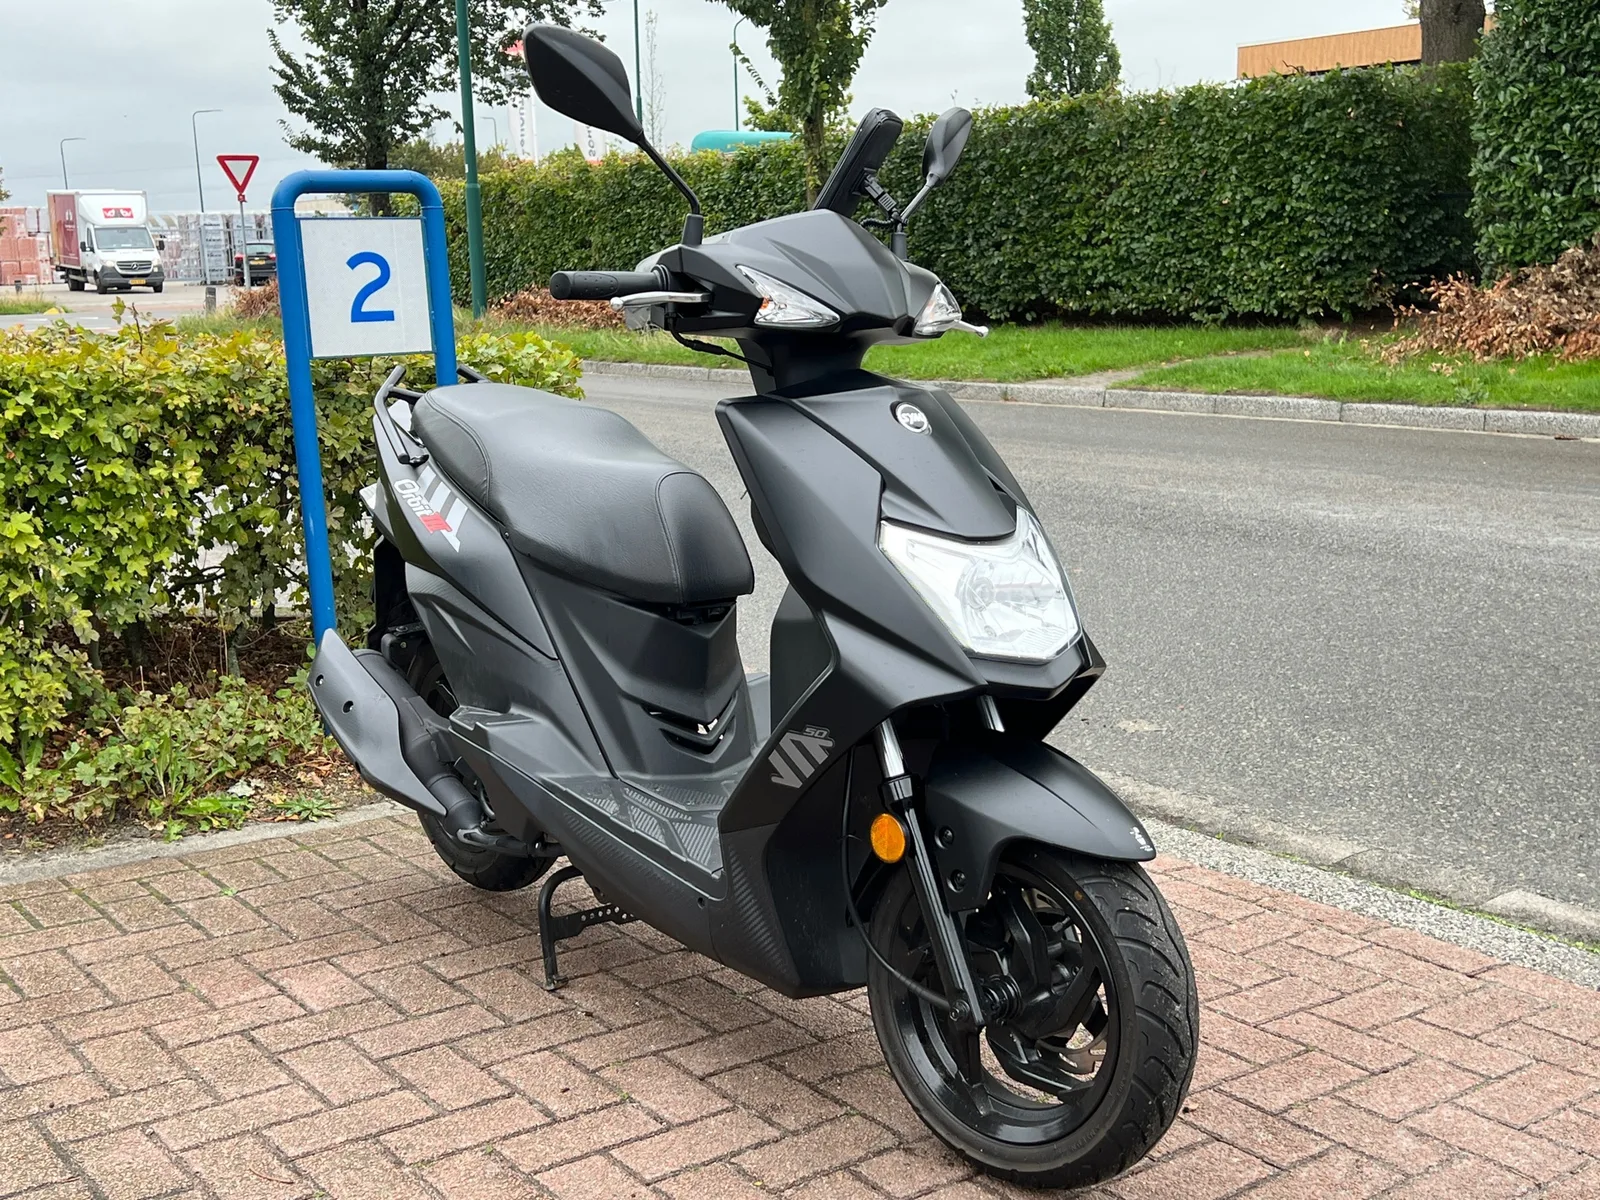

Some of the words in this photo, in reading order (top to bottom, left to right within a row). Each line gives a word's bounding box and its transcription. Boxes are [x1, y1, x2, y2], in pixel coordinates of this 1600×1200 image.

[346, 252, 395, 323] 2
[393, 479, 434, 517] Orbit
[803, 727, 828, 738] 50
